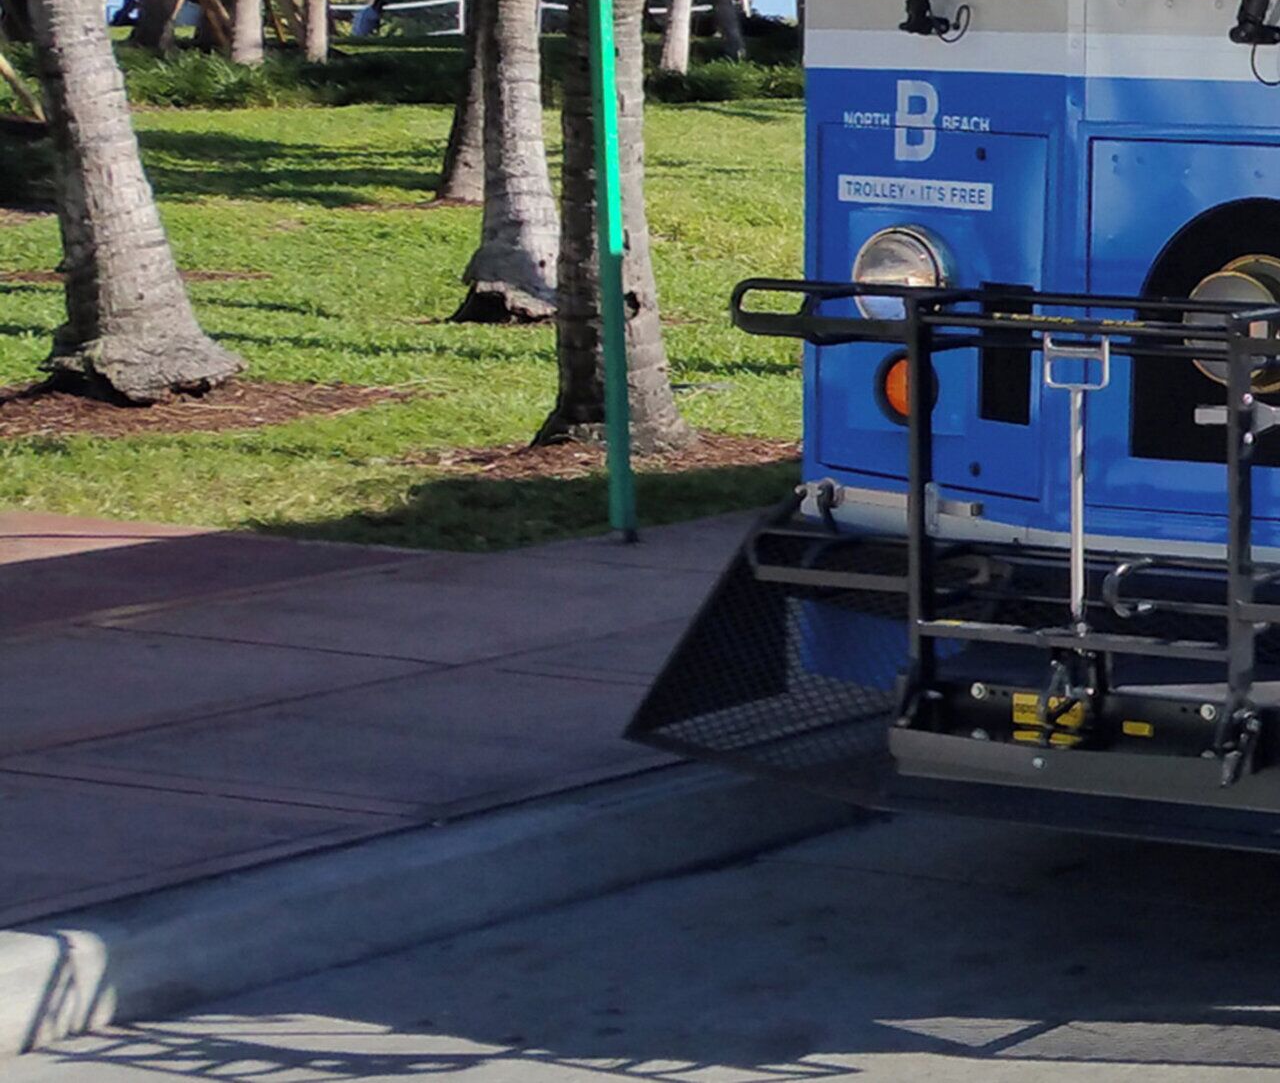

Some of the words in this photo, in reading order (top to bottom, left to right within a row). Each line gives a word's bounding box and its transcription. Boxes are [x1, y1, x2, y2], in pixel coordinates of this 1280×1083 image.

[844, 111, 891, 130] NORTH
[894, 79, 939, 162] B
[942, 115, 991, 133] BEACH
[846, 180, 906, 199] TROLLEY
[919, 184, 946, 202] IT'S
[950, 187, 987, 204] FREE
